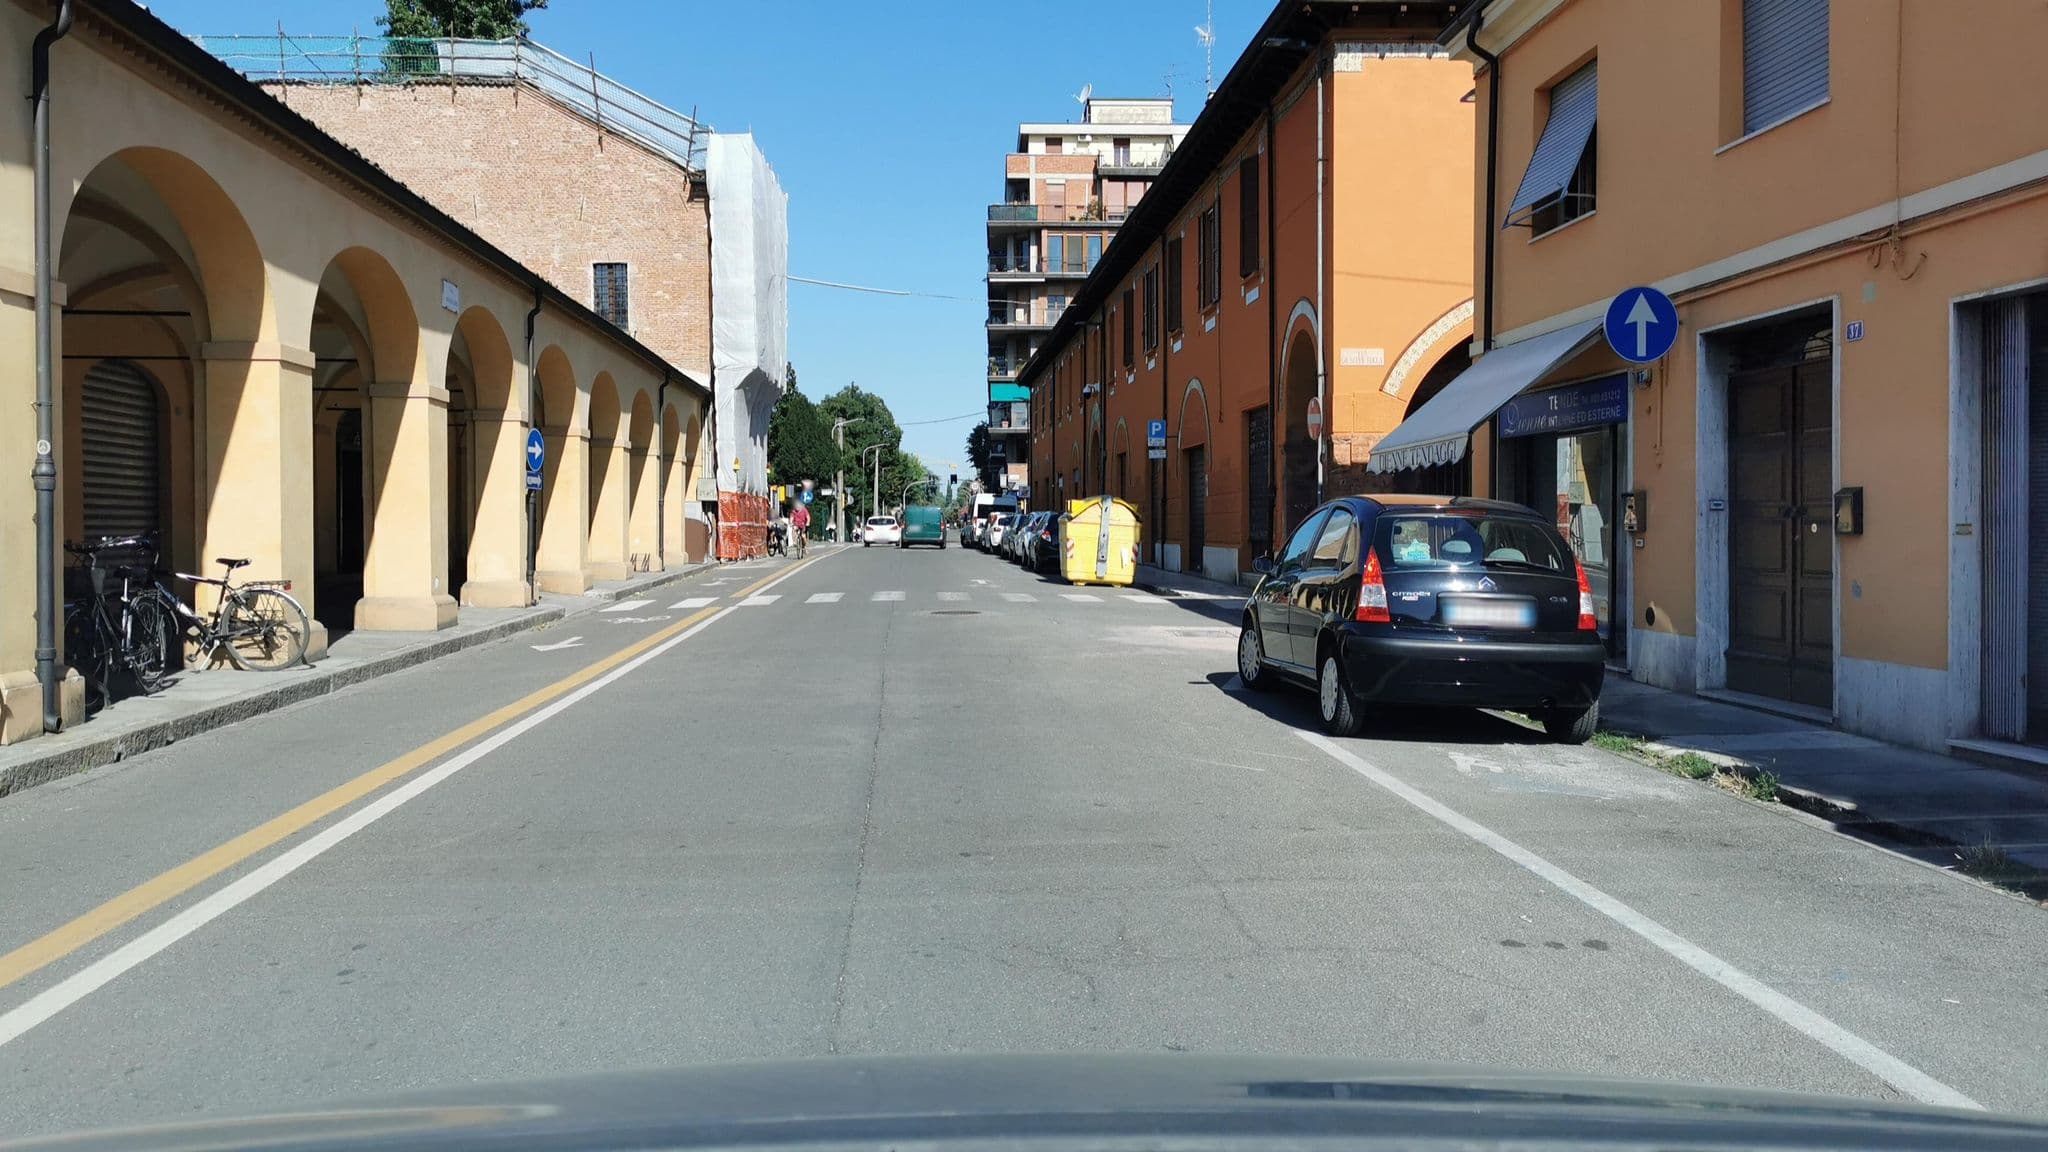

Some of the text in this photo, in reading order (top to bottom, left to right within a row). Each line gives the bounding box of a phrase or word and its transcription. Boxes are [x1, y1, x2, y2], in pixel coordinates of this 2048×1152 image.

[1548, 391, 1579, 410] TENDE
[1576, 411, 1587, 424] ED
[1587, 405, 1621, 421] ESTERNE
[1151, 422, 1162, 436] P
[1378, 440, 1457, 471] DIENNE TENDAGGI
